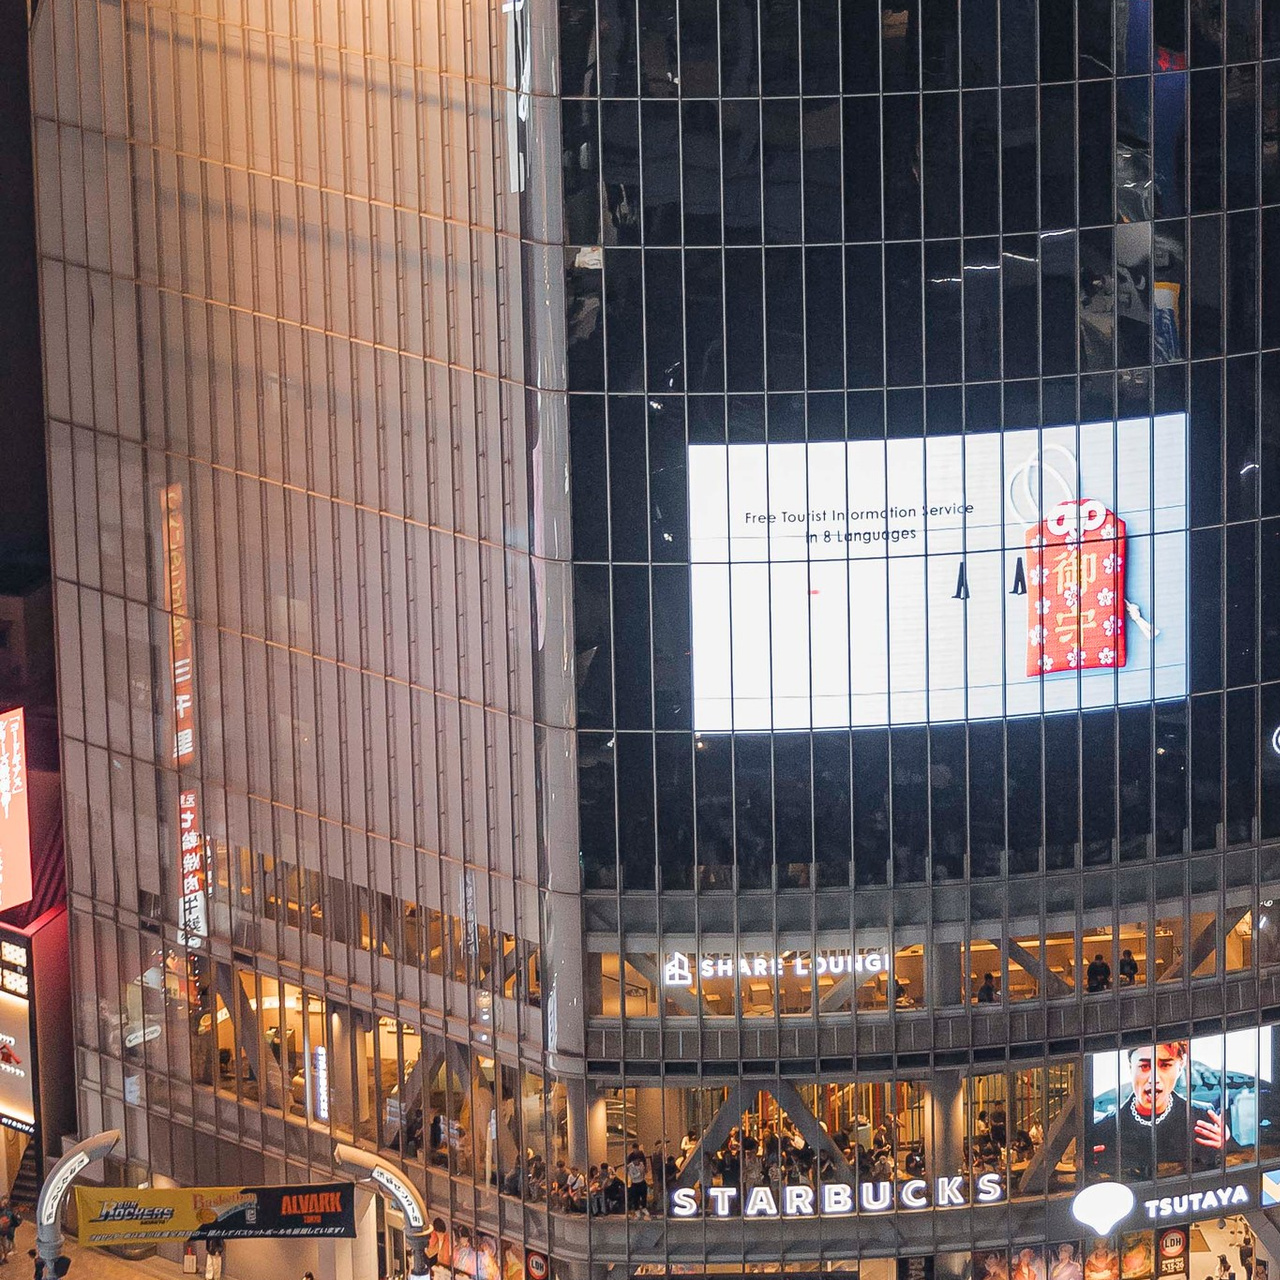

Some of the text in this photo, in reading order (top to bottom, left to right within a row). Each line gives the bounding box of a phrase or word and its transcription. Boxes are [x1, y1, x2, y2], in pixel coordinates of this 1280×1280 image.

[745, 512, 776, 524] Free
[832, 507, 916, 522] Inormation
[823, 529, 832, 543] 8
[1052, 550, 1097, 649] 御守
[281, 1192, 342, 1214] ALVARK
[672, 1173, 1003, 1217] STARBUCKS
[1144, 1185, 1249, 1220] TSUTAYA
[1164, 1236, 1182, 1249] LDH
